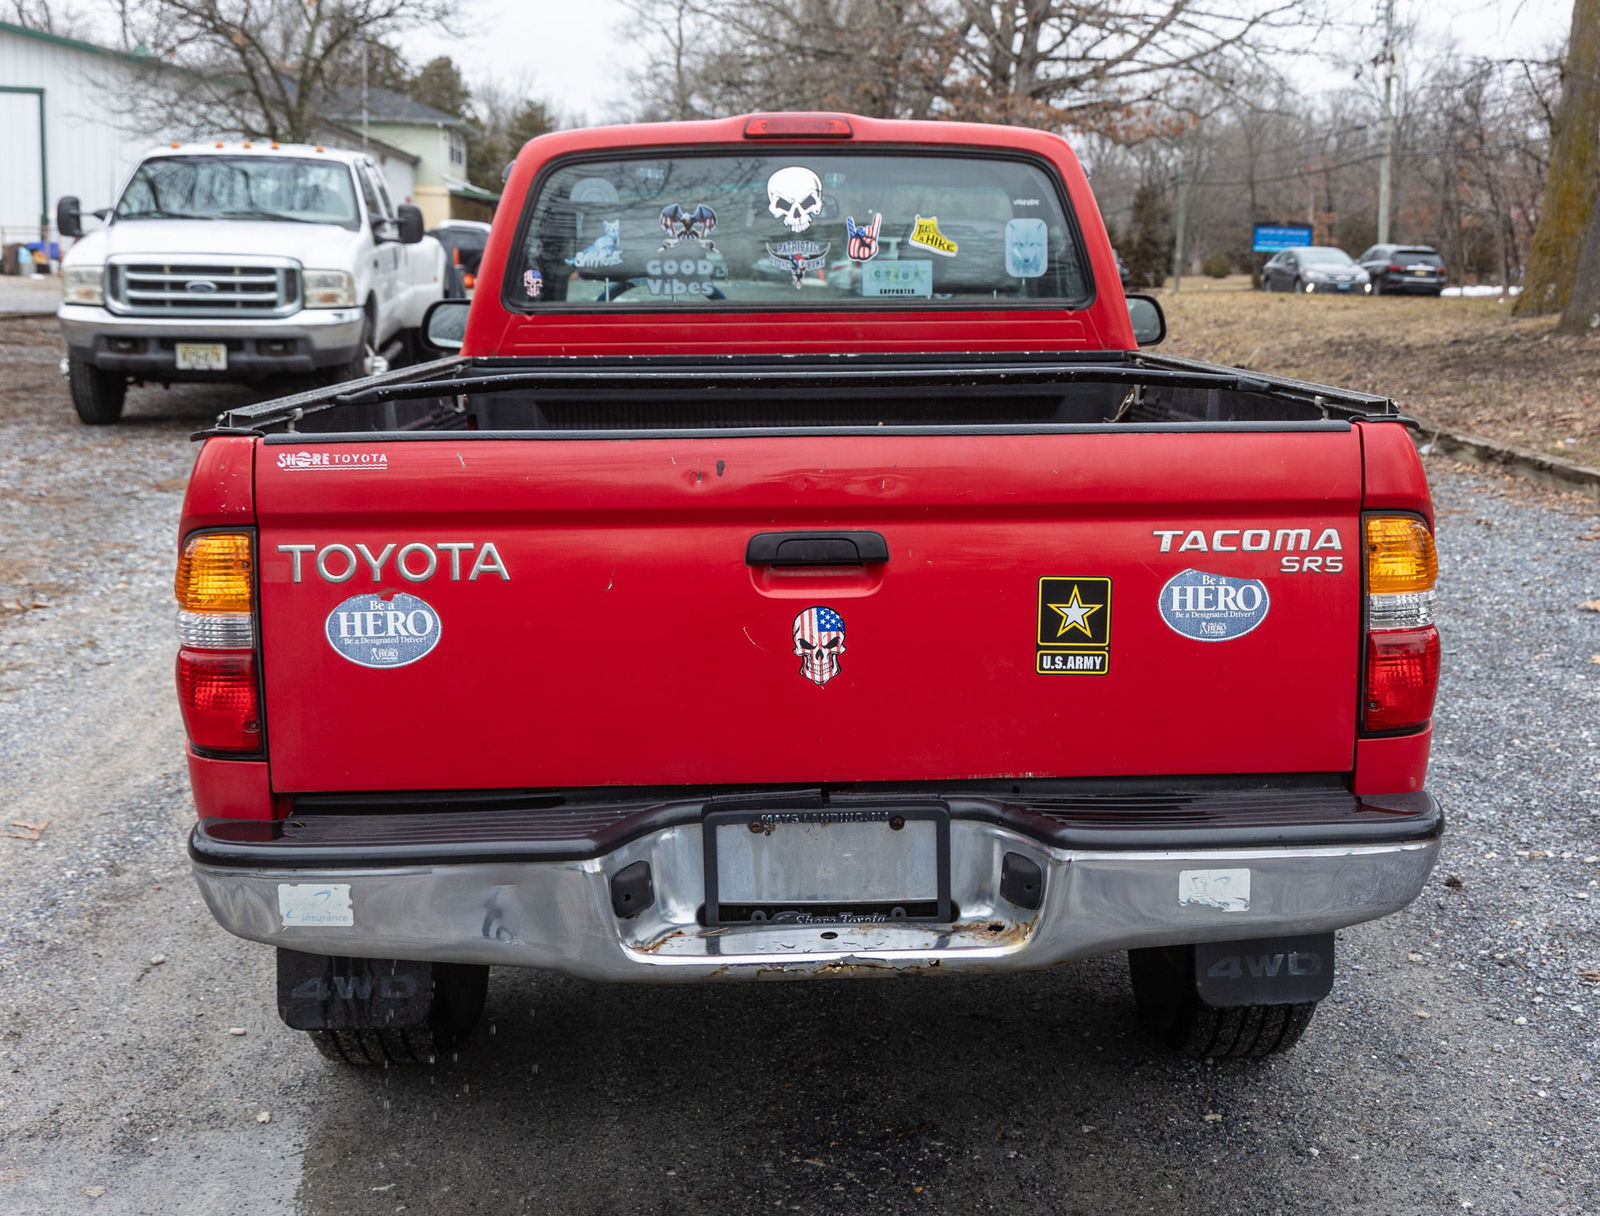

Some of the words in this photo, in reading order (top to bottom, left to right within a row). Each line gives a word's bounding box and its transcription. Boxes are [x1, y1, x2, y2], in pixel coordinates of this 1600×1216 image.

[926, 234, 955, 252] HIKE
[647, 260, 713, 275] GOOD
[647, 279, 715, 296] Vibes
[333, 453, 388, 464] TOYOTA
[1152, 528, 1344, 553] TACOMA
[277, 542, 511, 583] TOYOTA
[1279, 556, 1344, 573] SR5
[1202, 574, 1217, 585] Be
[1219, 577, 1227, 585] a
[370, 600, 385, 611] Be
[387, 602, 395, 611] a
[1170, 585, 1263, 612] HERO
[336, 609, 434, 638] HERO
[1175, 611, 1185, 619] Be
[1191, 611, 1228, 620] Designated
[344, 637, 354, 645] Be
[361, 636, 399, 646] Designated
[761, 813, 799, 825] MAYS
[1206, 951, 1322, 978] 4WD
[290, 975, 417, 1000] 4WD
